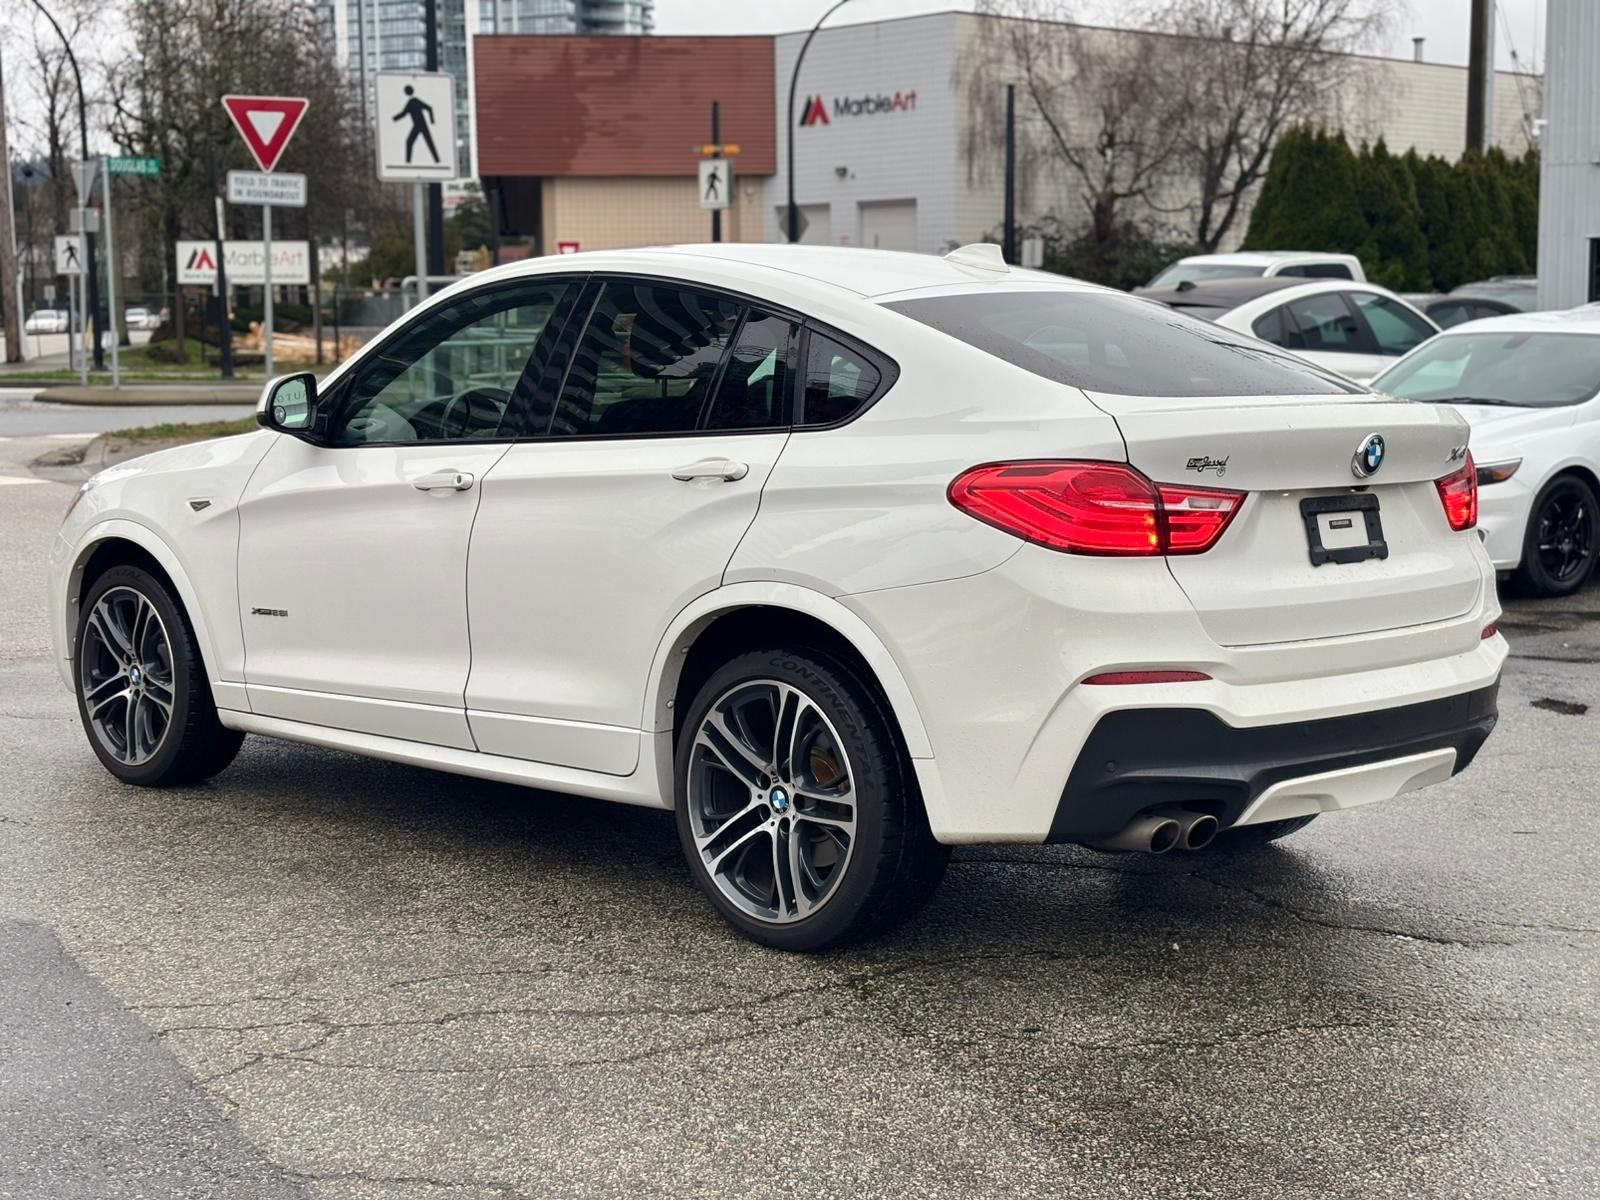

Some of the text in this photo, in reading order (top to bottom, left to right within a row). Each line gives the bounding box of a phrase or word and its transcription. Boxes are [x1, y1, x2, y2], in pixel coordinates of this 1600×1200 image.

[834, 90, 917, 117] MarbleArt
[110, 158, 146, 173] DOUGLAS
[234, 176, 301, 190] YIELD TO TRAFFIC
[233, 189, 301, 200] IN ROUNDABOUT
